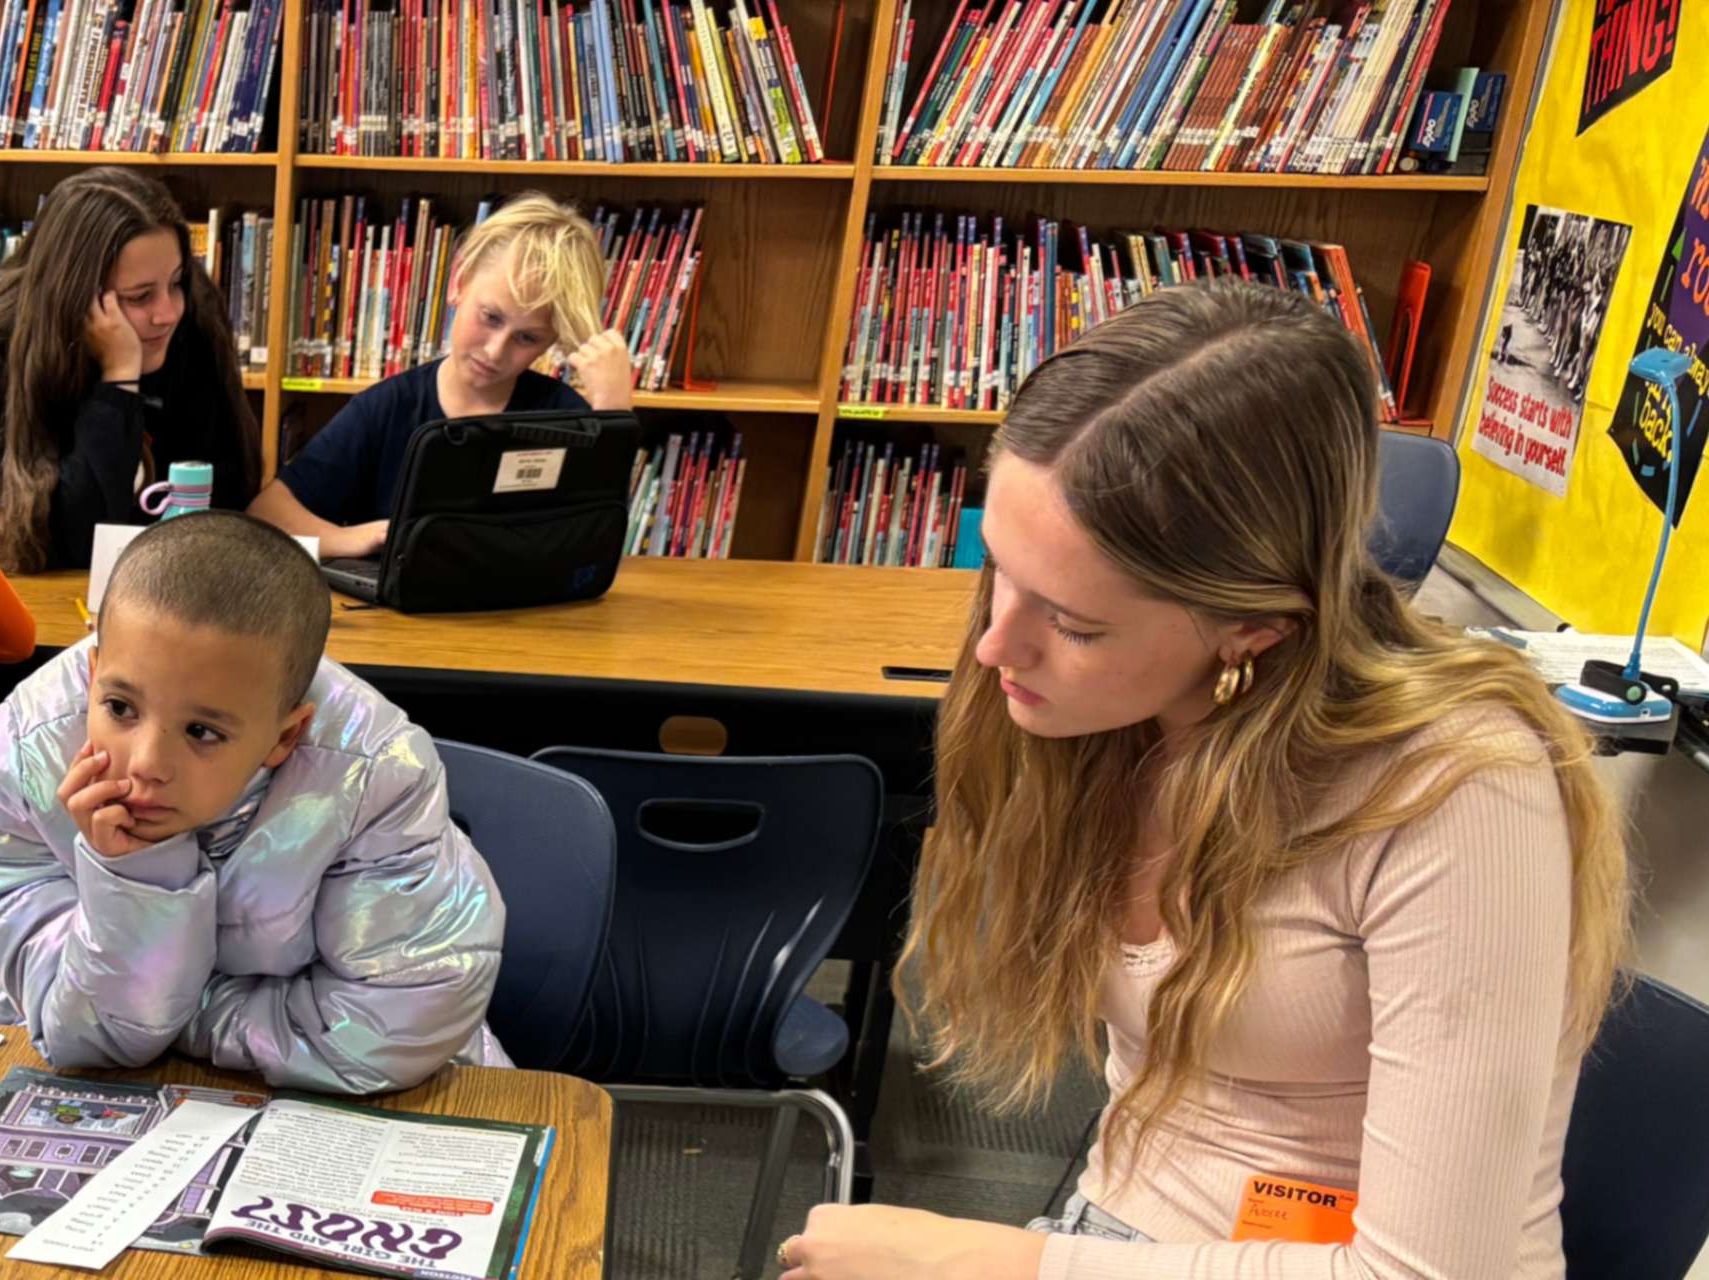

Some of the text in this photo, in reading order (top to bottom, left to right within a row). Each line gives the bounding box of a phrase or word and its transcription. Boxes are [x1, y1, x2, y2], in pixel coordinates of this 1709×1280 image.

[1586, 0, 1678, 114] THING!
[1486, 377, 1574, 440] Success starts with
[1478, 407, 1514, 456] believing
[1513, 424, 1524, 449] in
[1252, 1180, 1338, 1208] VISITOR
[244, 1217, 282, 1235] THE
[290, 1230, 331, 1247] AND
[343, 1241, 391, 1260] GIRL
[398, 1254, 436, 1268] THE
